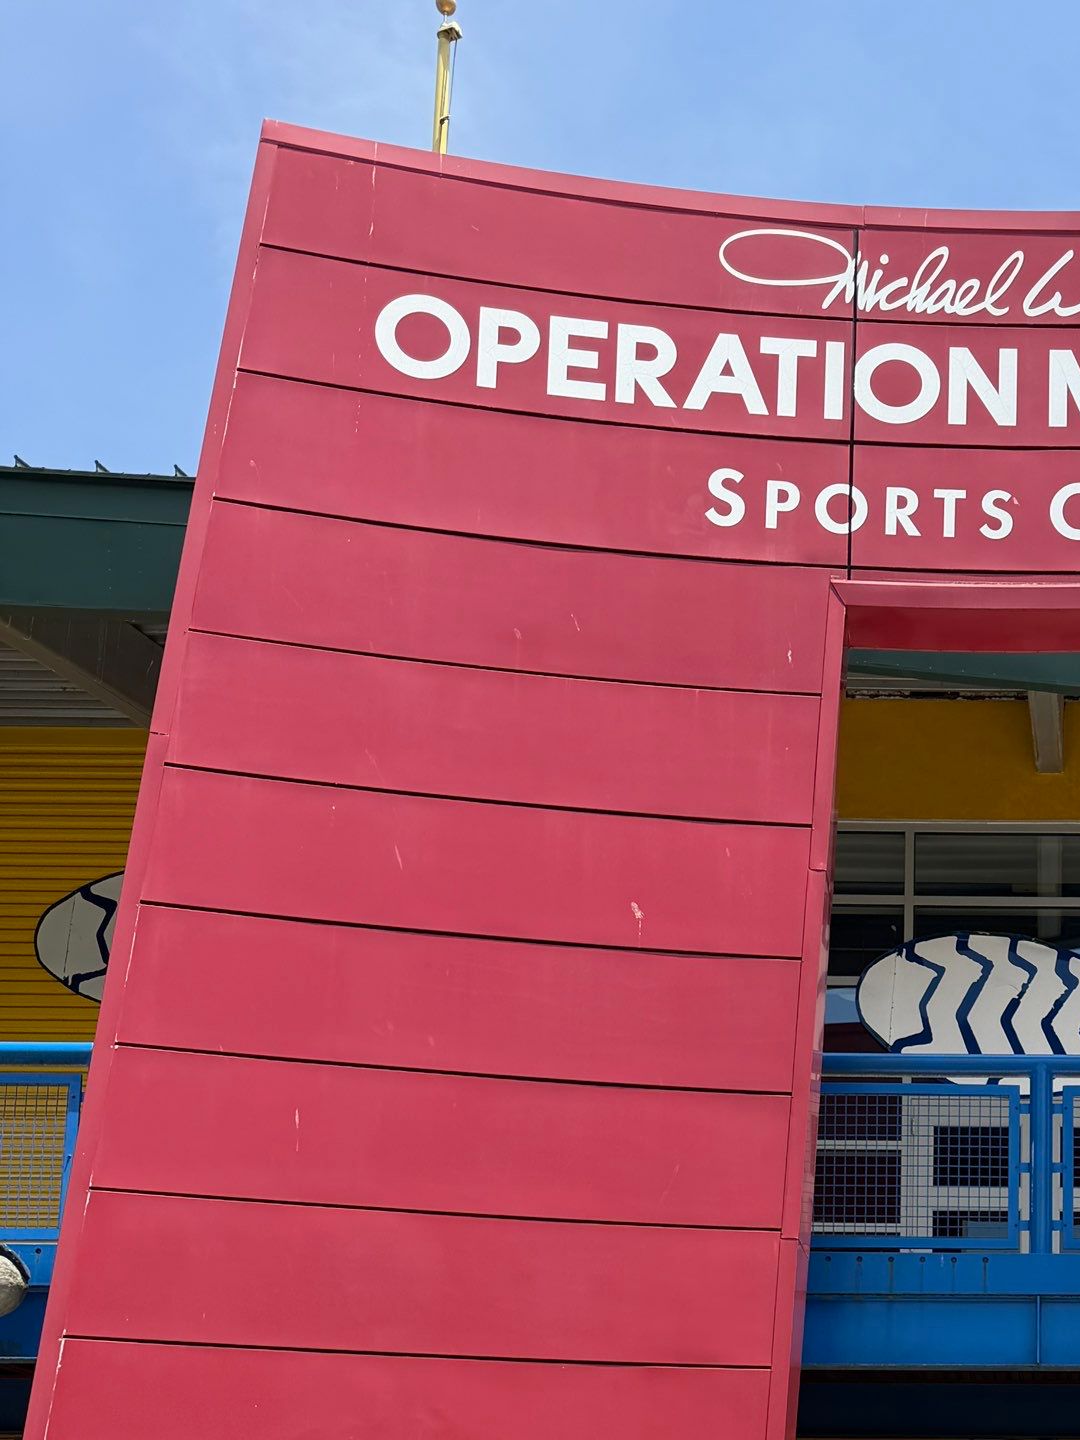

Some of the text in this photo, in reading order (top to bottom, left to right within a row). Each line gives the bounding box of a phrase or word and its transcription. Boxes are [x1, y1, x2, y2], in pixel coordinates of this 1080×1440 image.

[719, 229, 1025, 317] Michael
[374, 293, 1018, 427] OPERATION
[704, 467, 1014, 540] SPORTS
